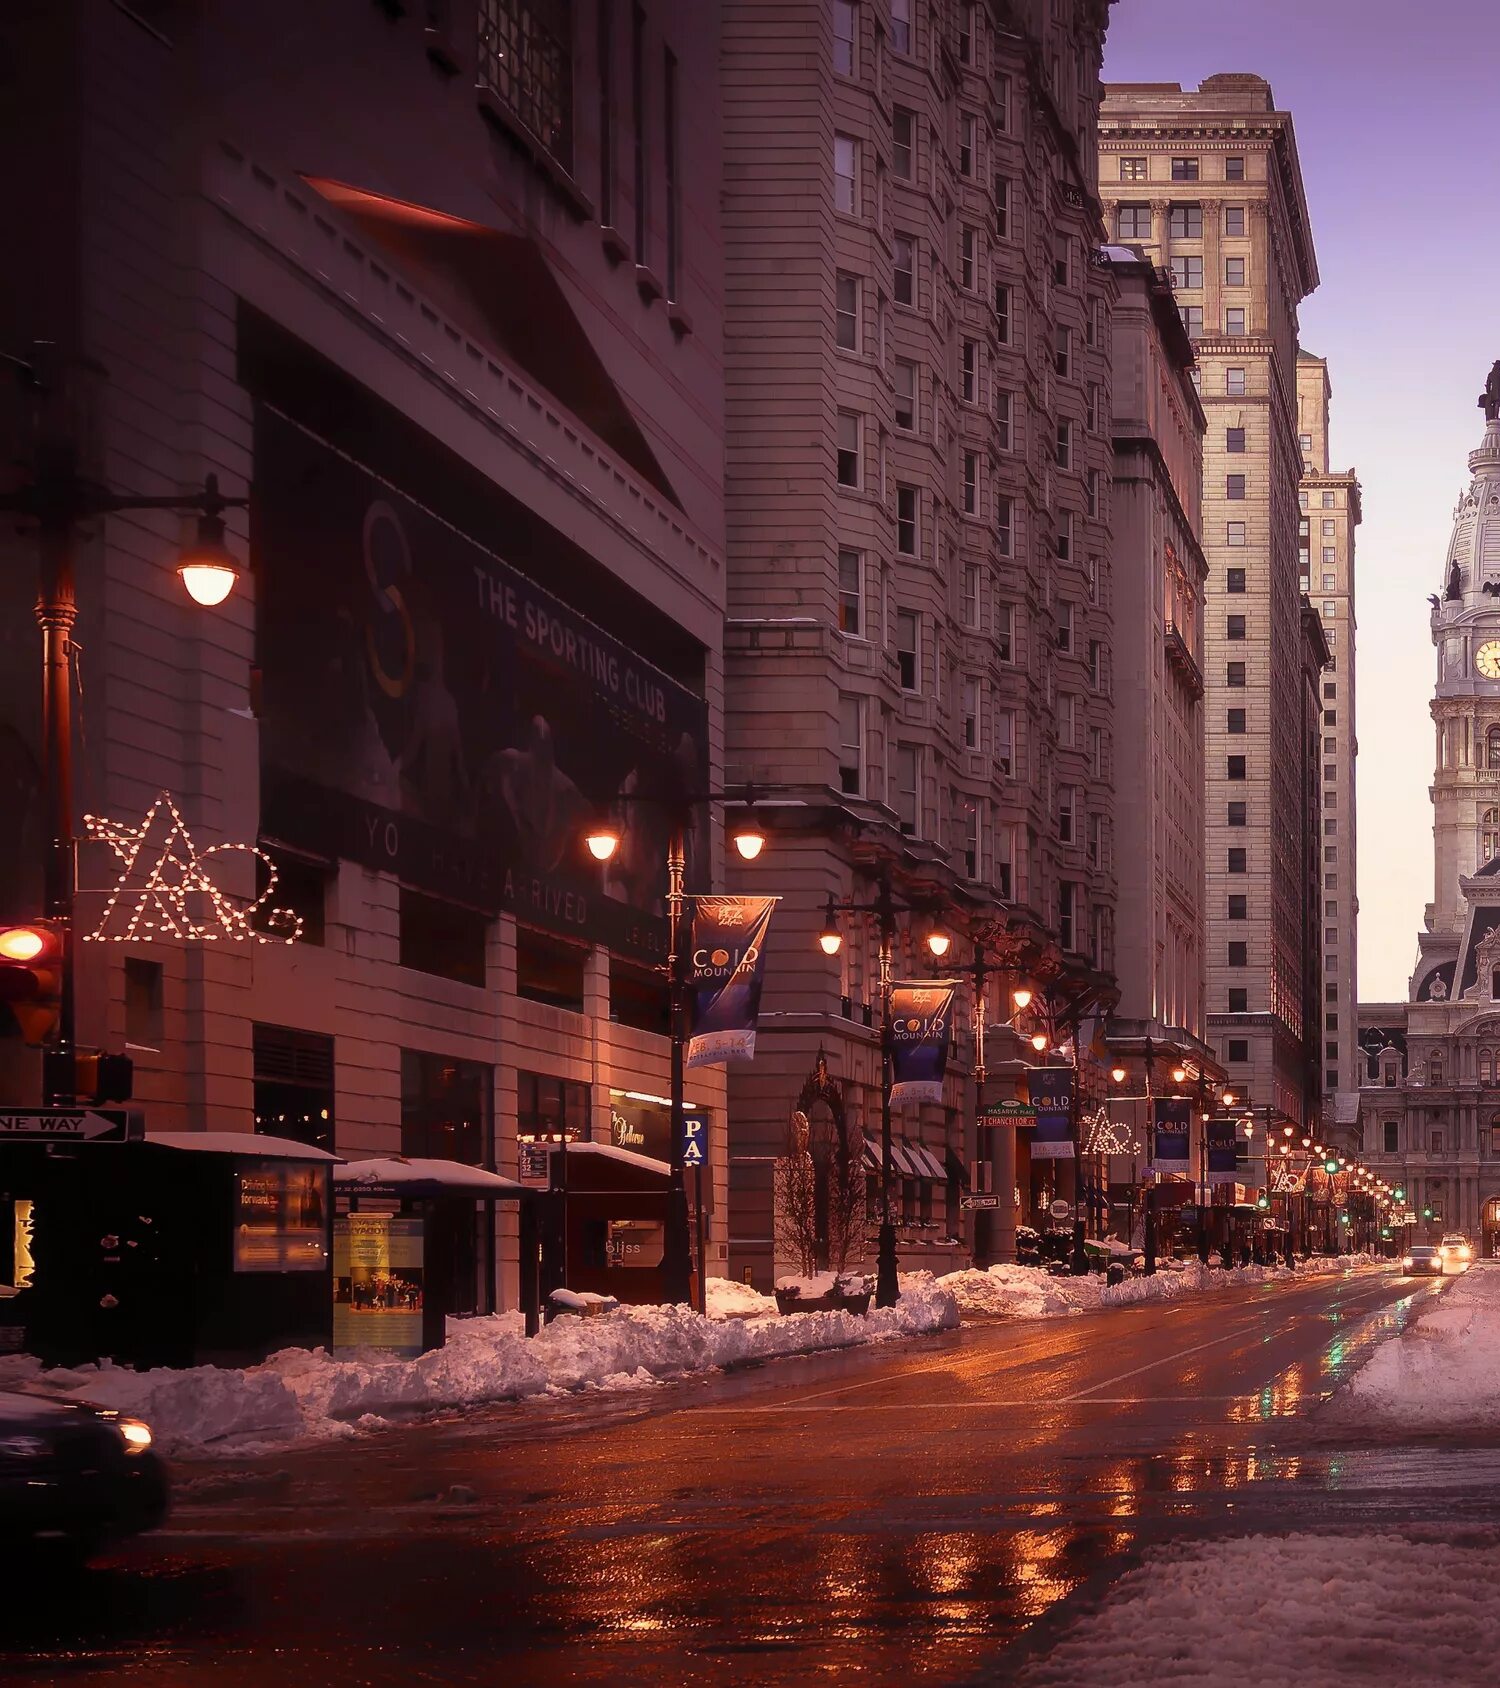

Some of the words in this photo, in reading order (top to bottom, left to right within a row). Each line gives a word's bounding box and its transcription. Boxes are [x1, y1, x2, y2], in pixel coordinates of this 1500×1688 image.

[474, 565, 517, 629] THE
[524, 600, 619, 693] SPORTING
[625, 667, 666, 723] CLUB
[0, 1118, 30, 1130] NE
[39, 1118, 83, 1131] WAY
[988, 1117, 1027, 1126] CHANCELLOR
[1157, 1121, 1188, 1130] COLD
[521, 1164, 532, 1172] 32
[605, 1241, 641, 1254] bliss
